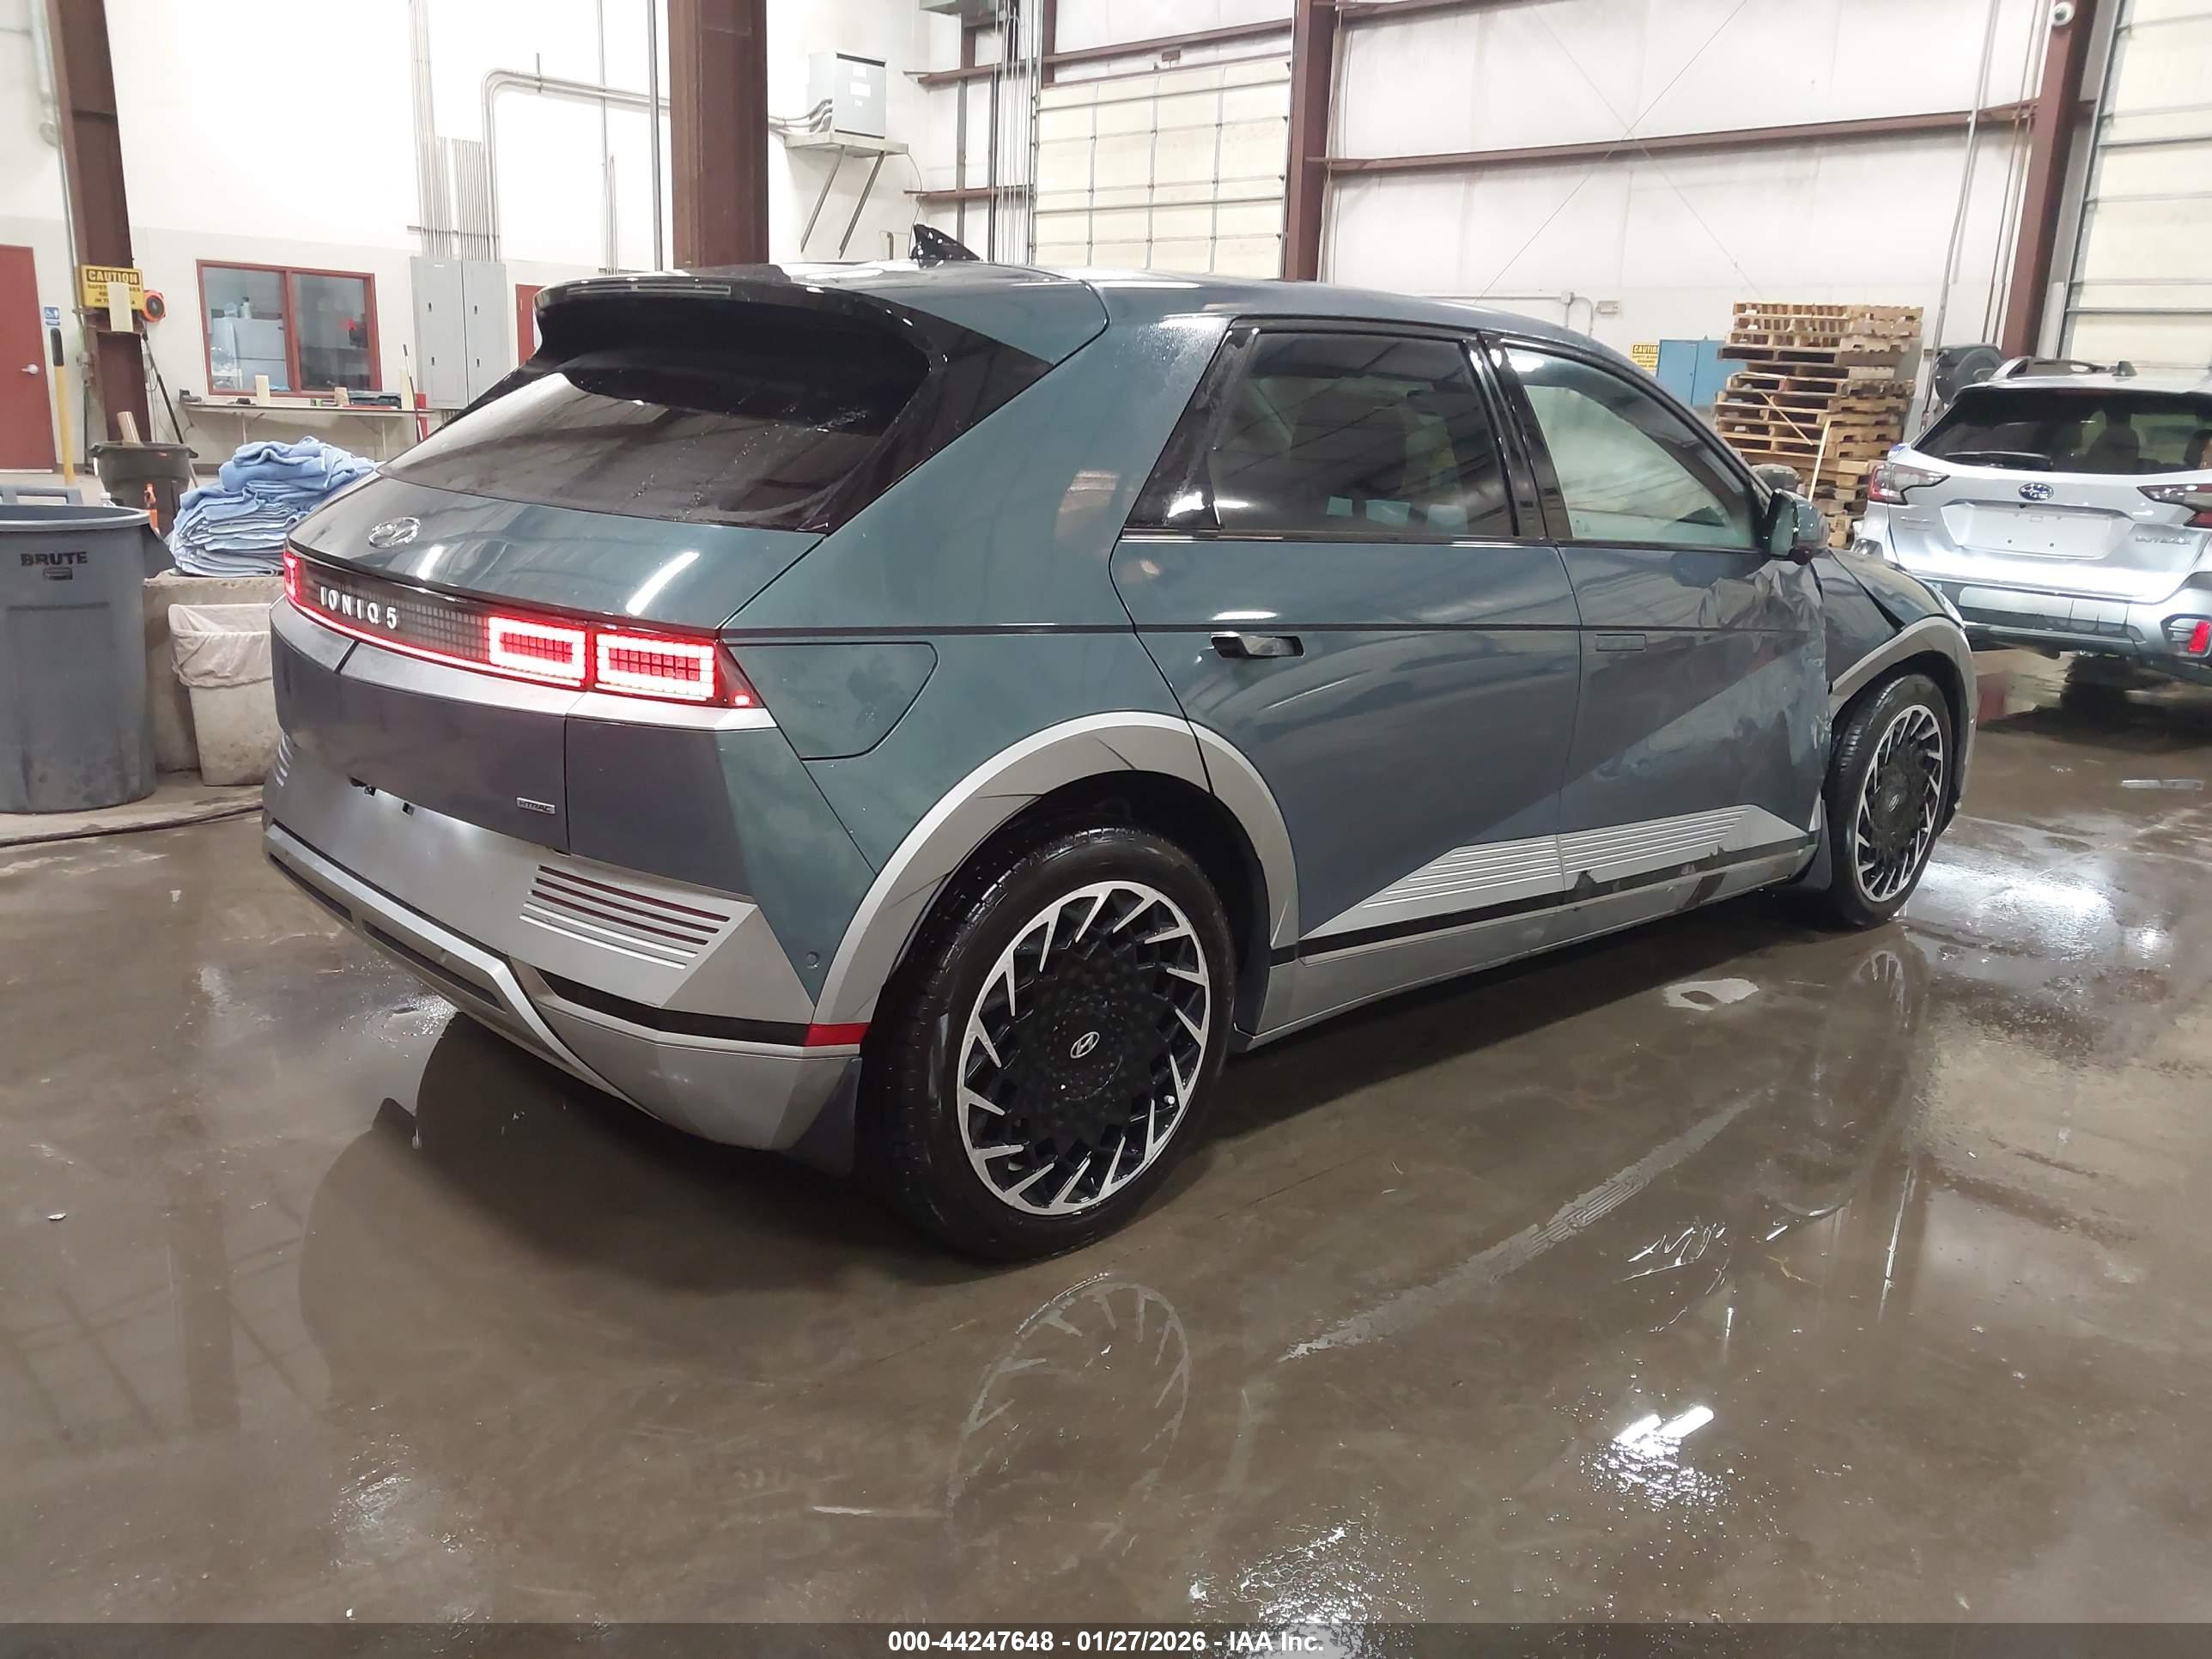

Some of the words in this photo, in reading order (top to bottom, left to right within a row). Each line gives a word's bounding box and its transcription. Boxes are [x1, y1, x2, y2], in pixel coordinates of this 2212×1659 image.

[88, 270, 138, 284] CAUTION
[20, 551, 88, 567] BRUTE
[320, 586, 381, 625] IONIQ
[386, 606, 398, 629] 5
